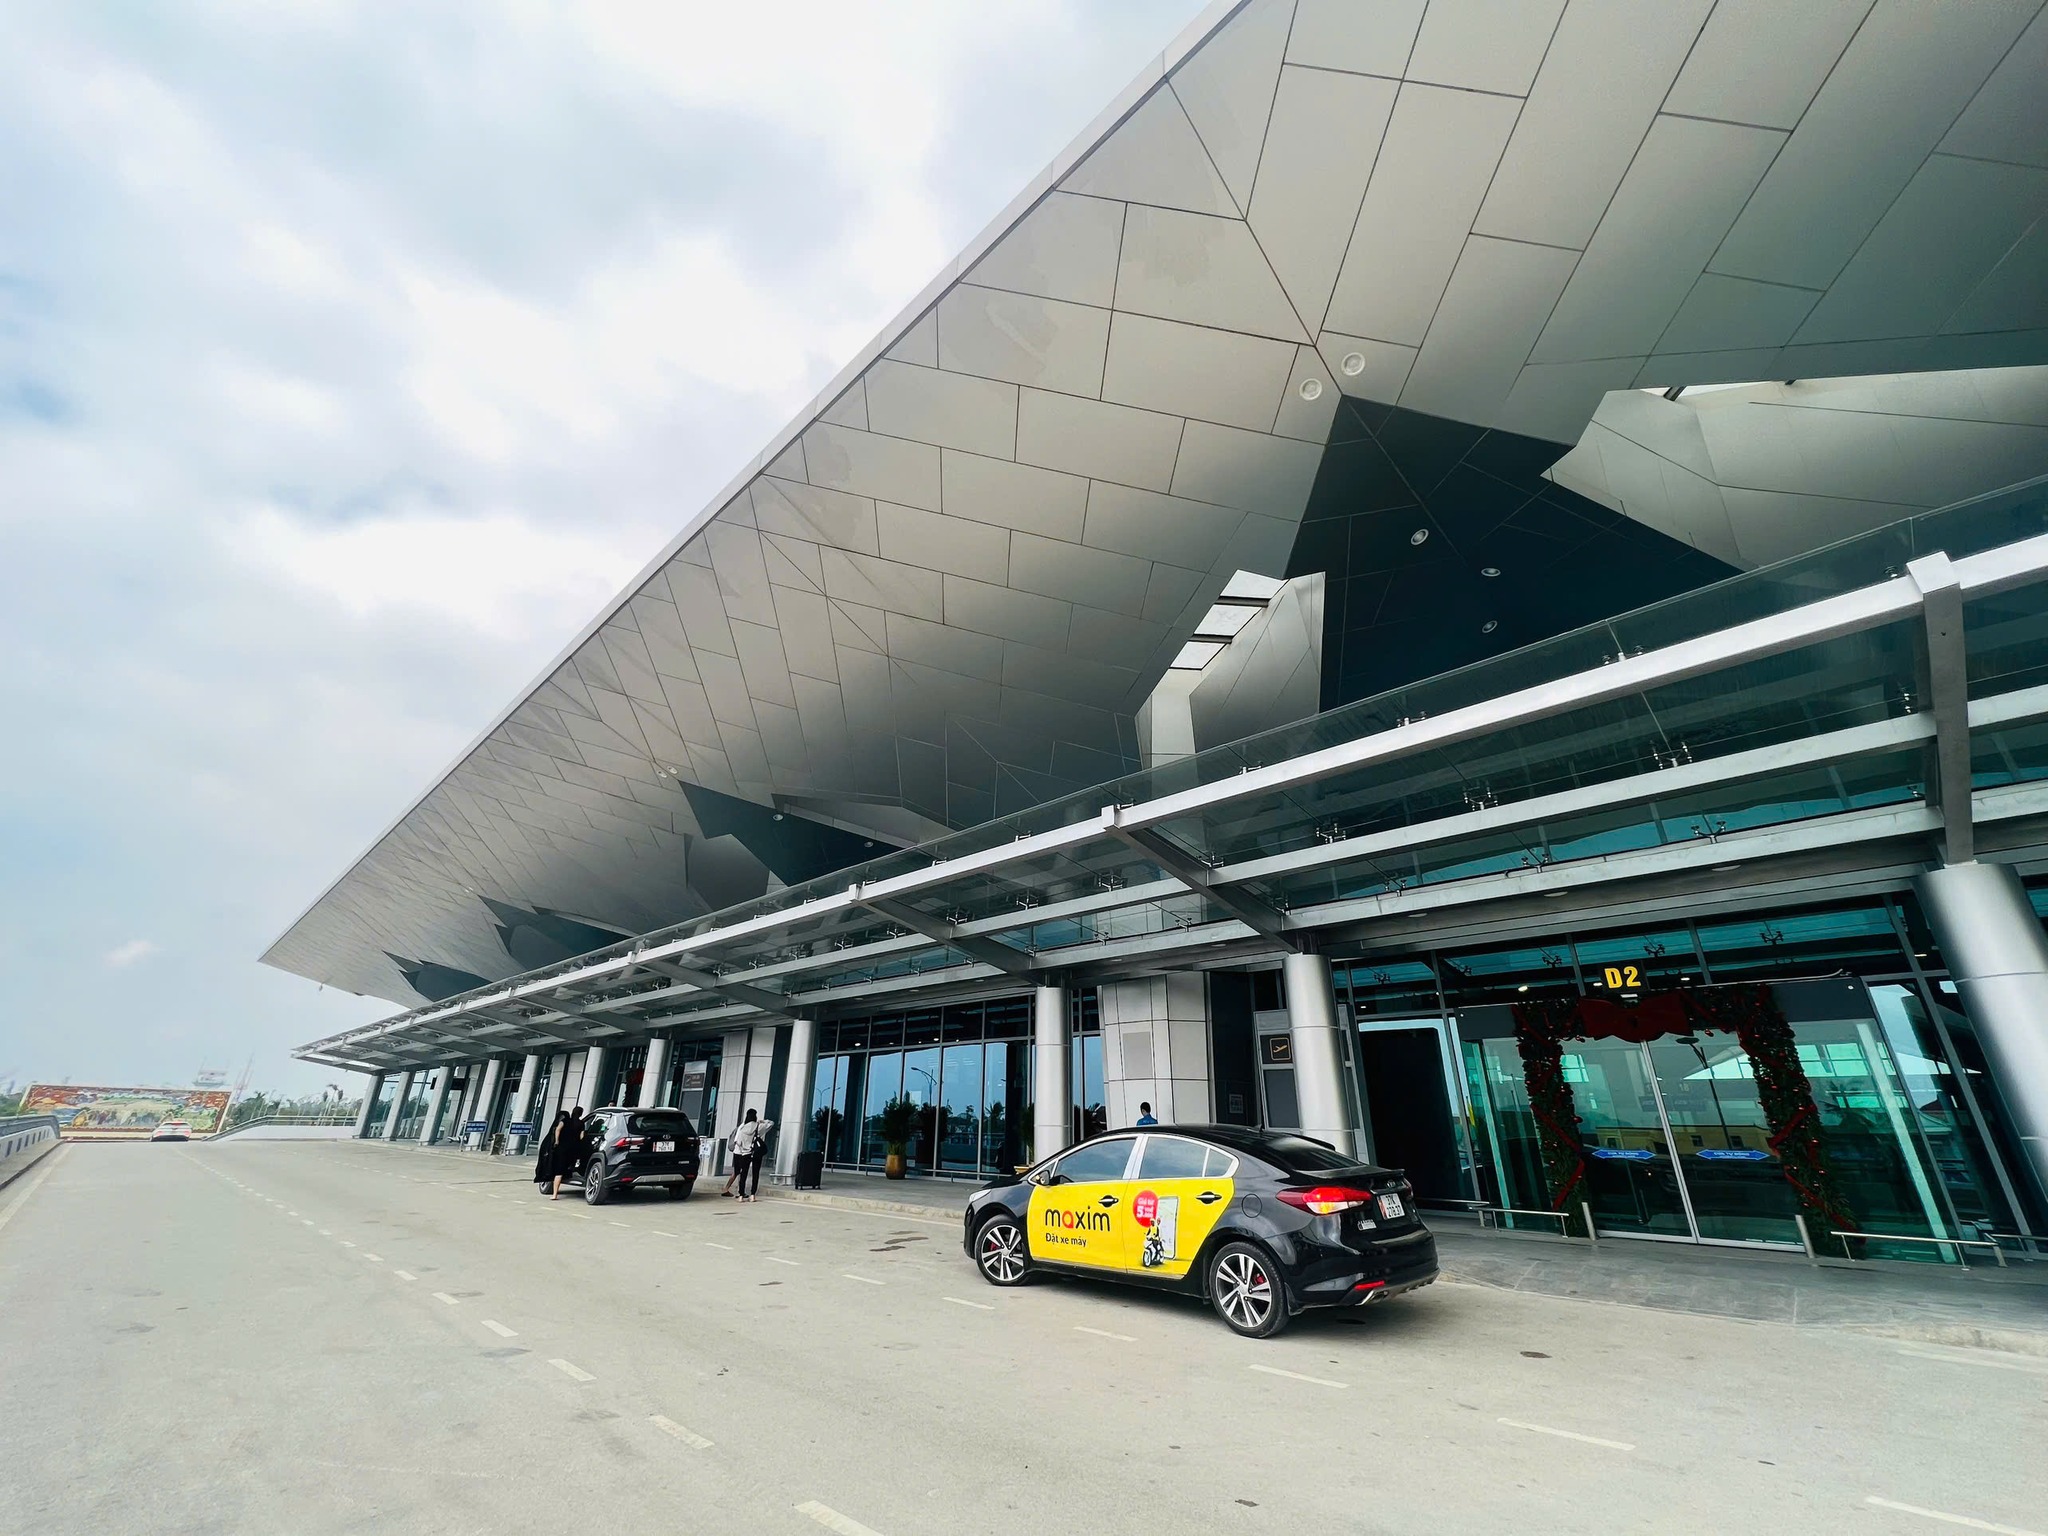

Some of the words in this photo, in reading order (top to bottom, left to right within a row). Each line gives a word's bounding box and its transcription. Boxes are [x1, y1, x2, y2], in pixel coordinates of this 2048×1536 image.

[1604, 966, 1642, 989] D2
[1045, 1205, 1110, 1232] maxim
[1045, 1232, 1059, 1245] Đặt
[1060, 1236, 1069, 1244] xe
[1071, 1235, 1087, 1248] máy
